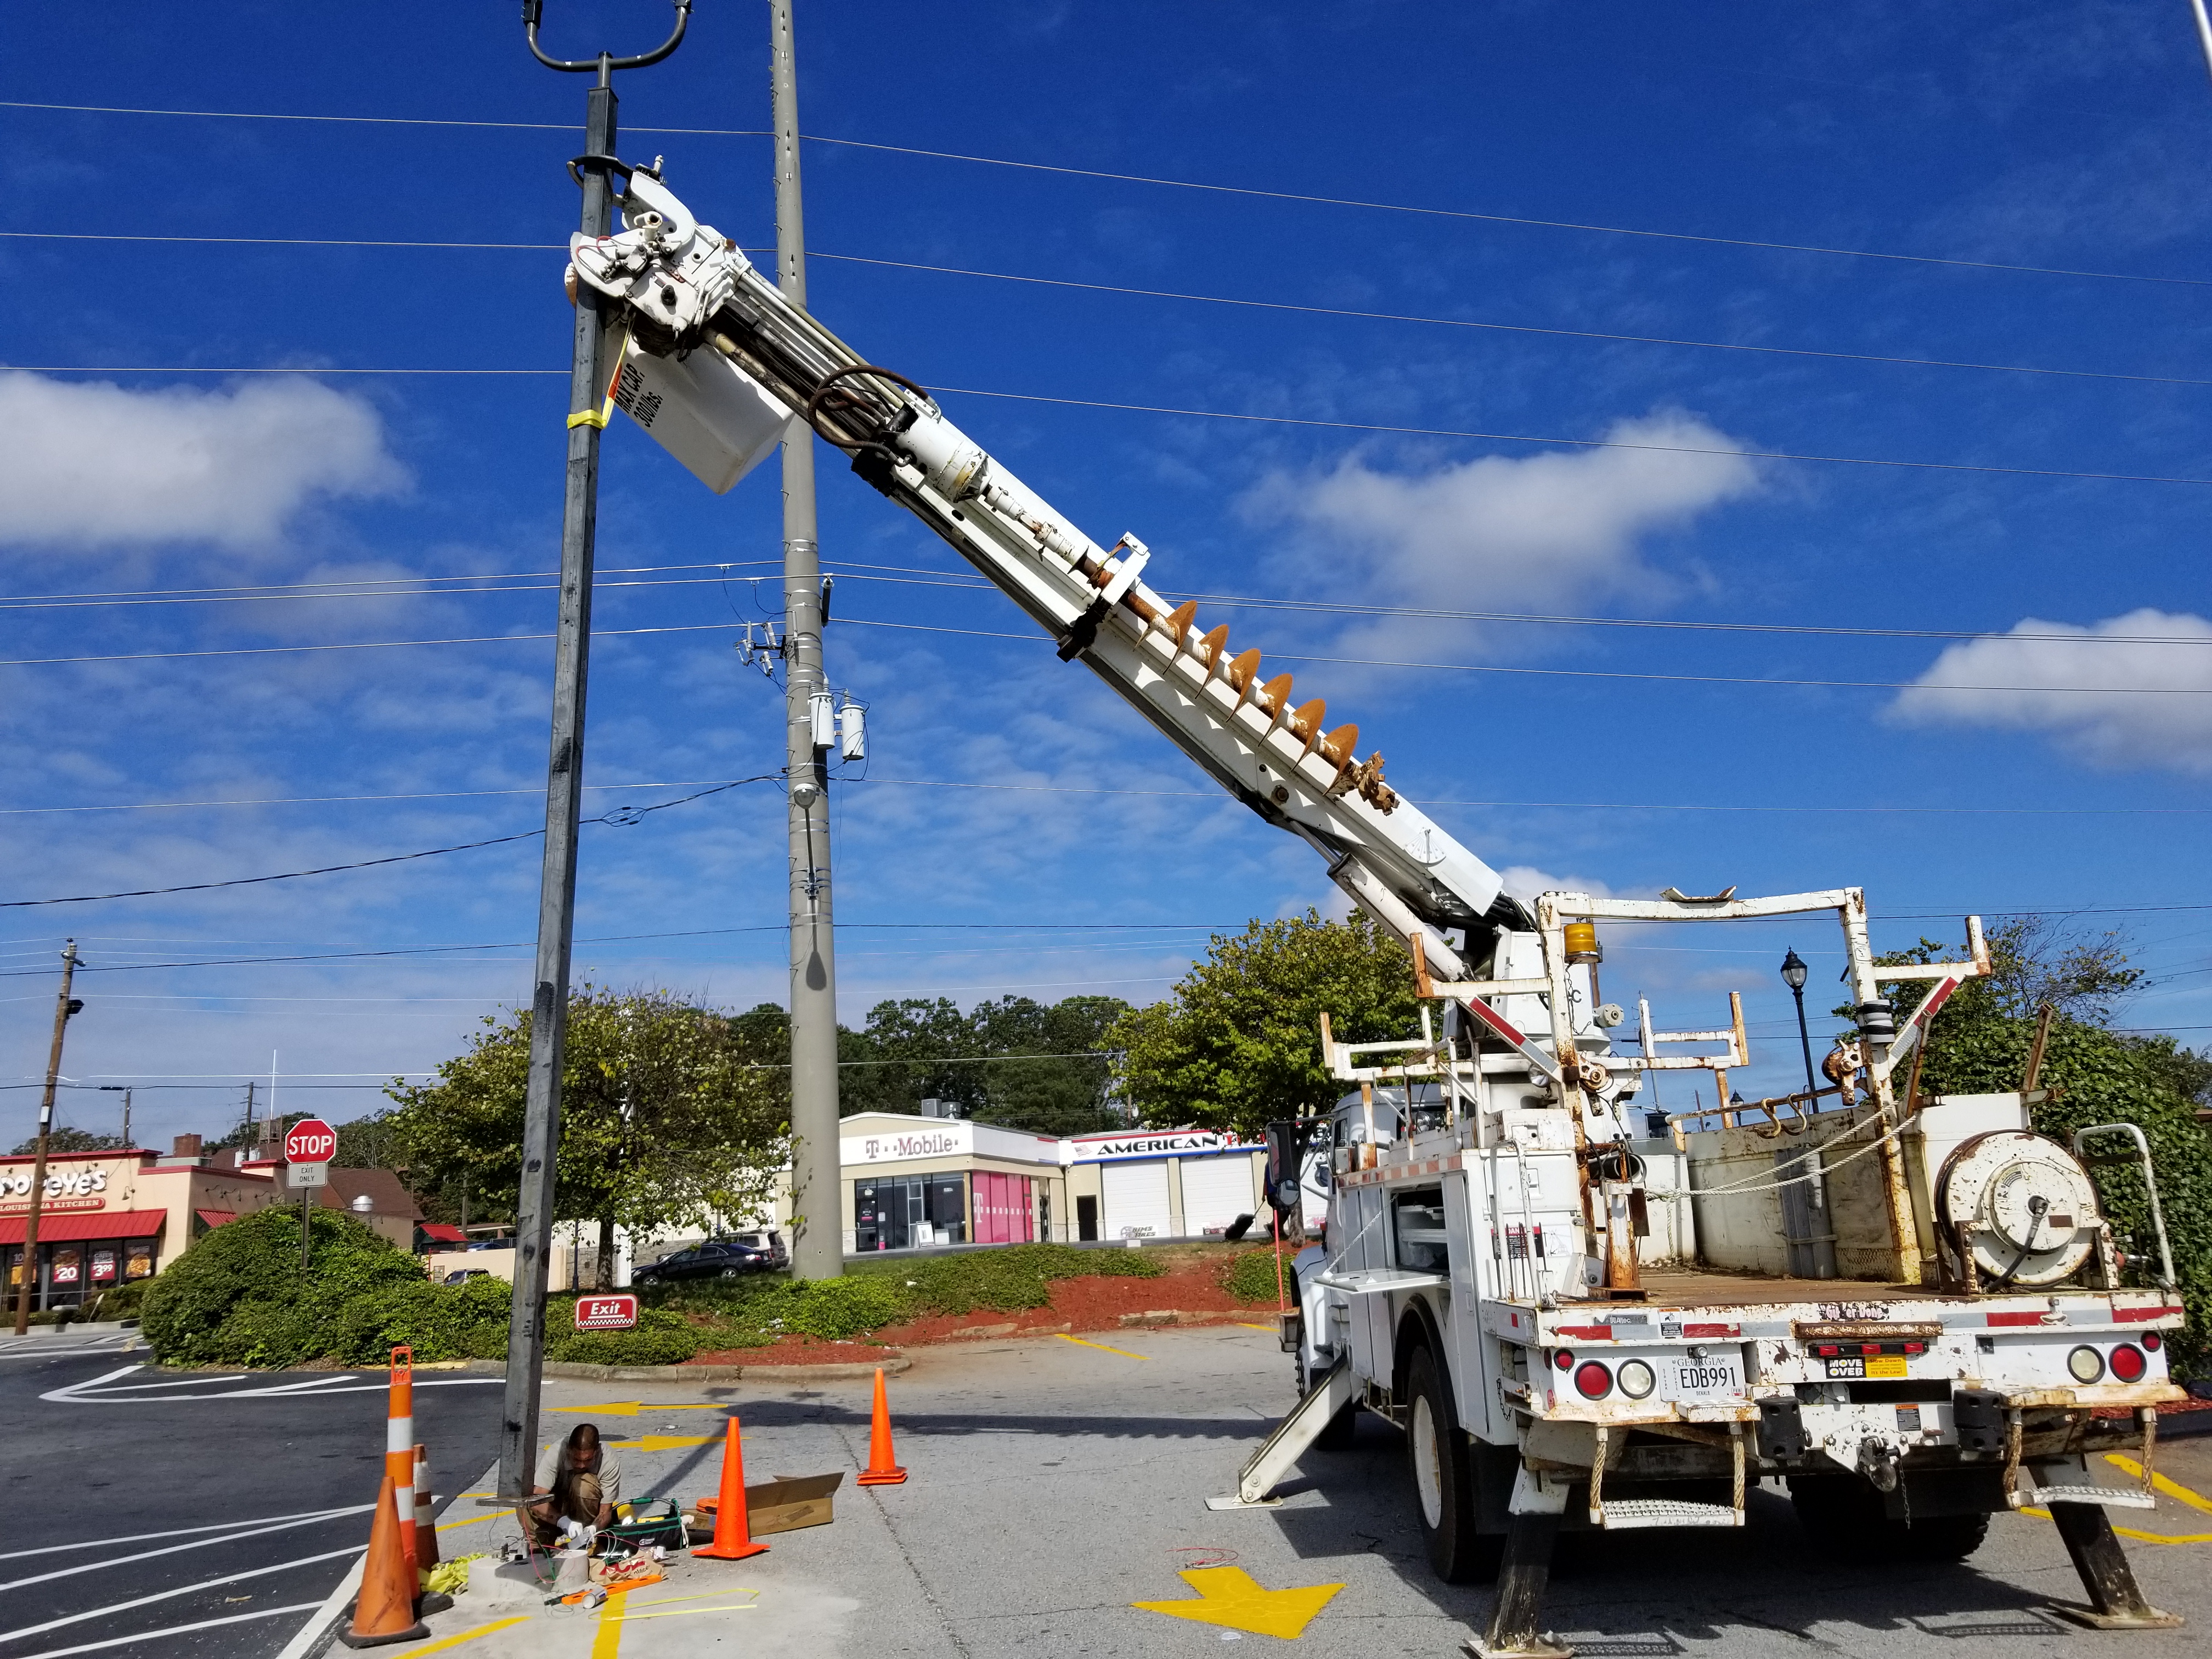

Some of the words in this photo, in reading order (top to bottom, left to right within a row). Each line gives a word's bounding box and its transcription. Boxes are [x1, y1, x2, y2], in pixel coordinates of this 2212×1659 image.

[614, 381, 636, 414] MAX
[288, 1135, 332, 1155] STOP
[1097, 1135, 1218, 1155] AMERICAN
[53, 1199, 99, 1209] KITCHEN
[55, 1267, 77, 1279] $20
[590, 1301, 620, 1315] Exit
[1677, 1357, 1723, 1367] GEORGIA
[1829, 1359, 1863, 1368] MOVE
[1680, 1367, 1736, 1389] EDB991
[1829, 1367, 1864, 1376] OVER
